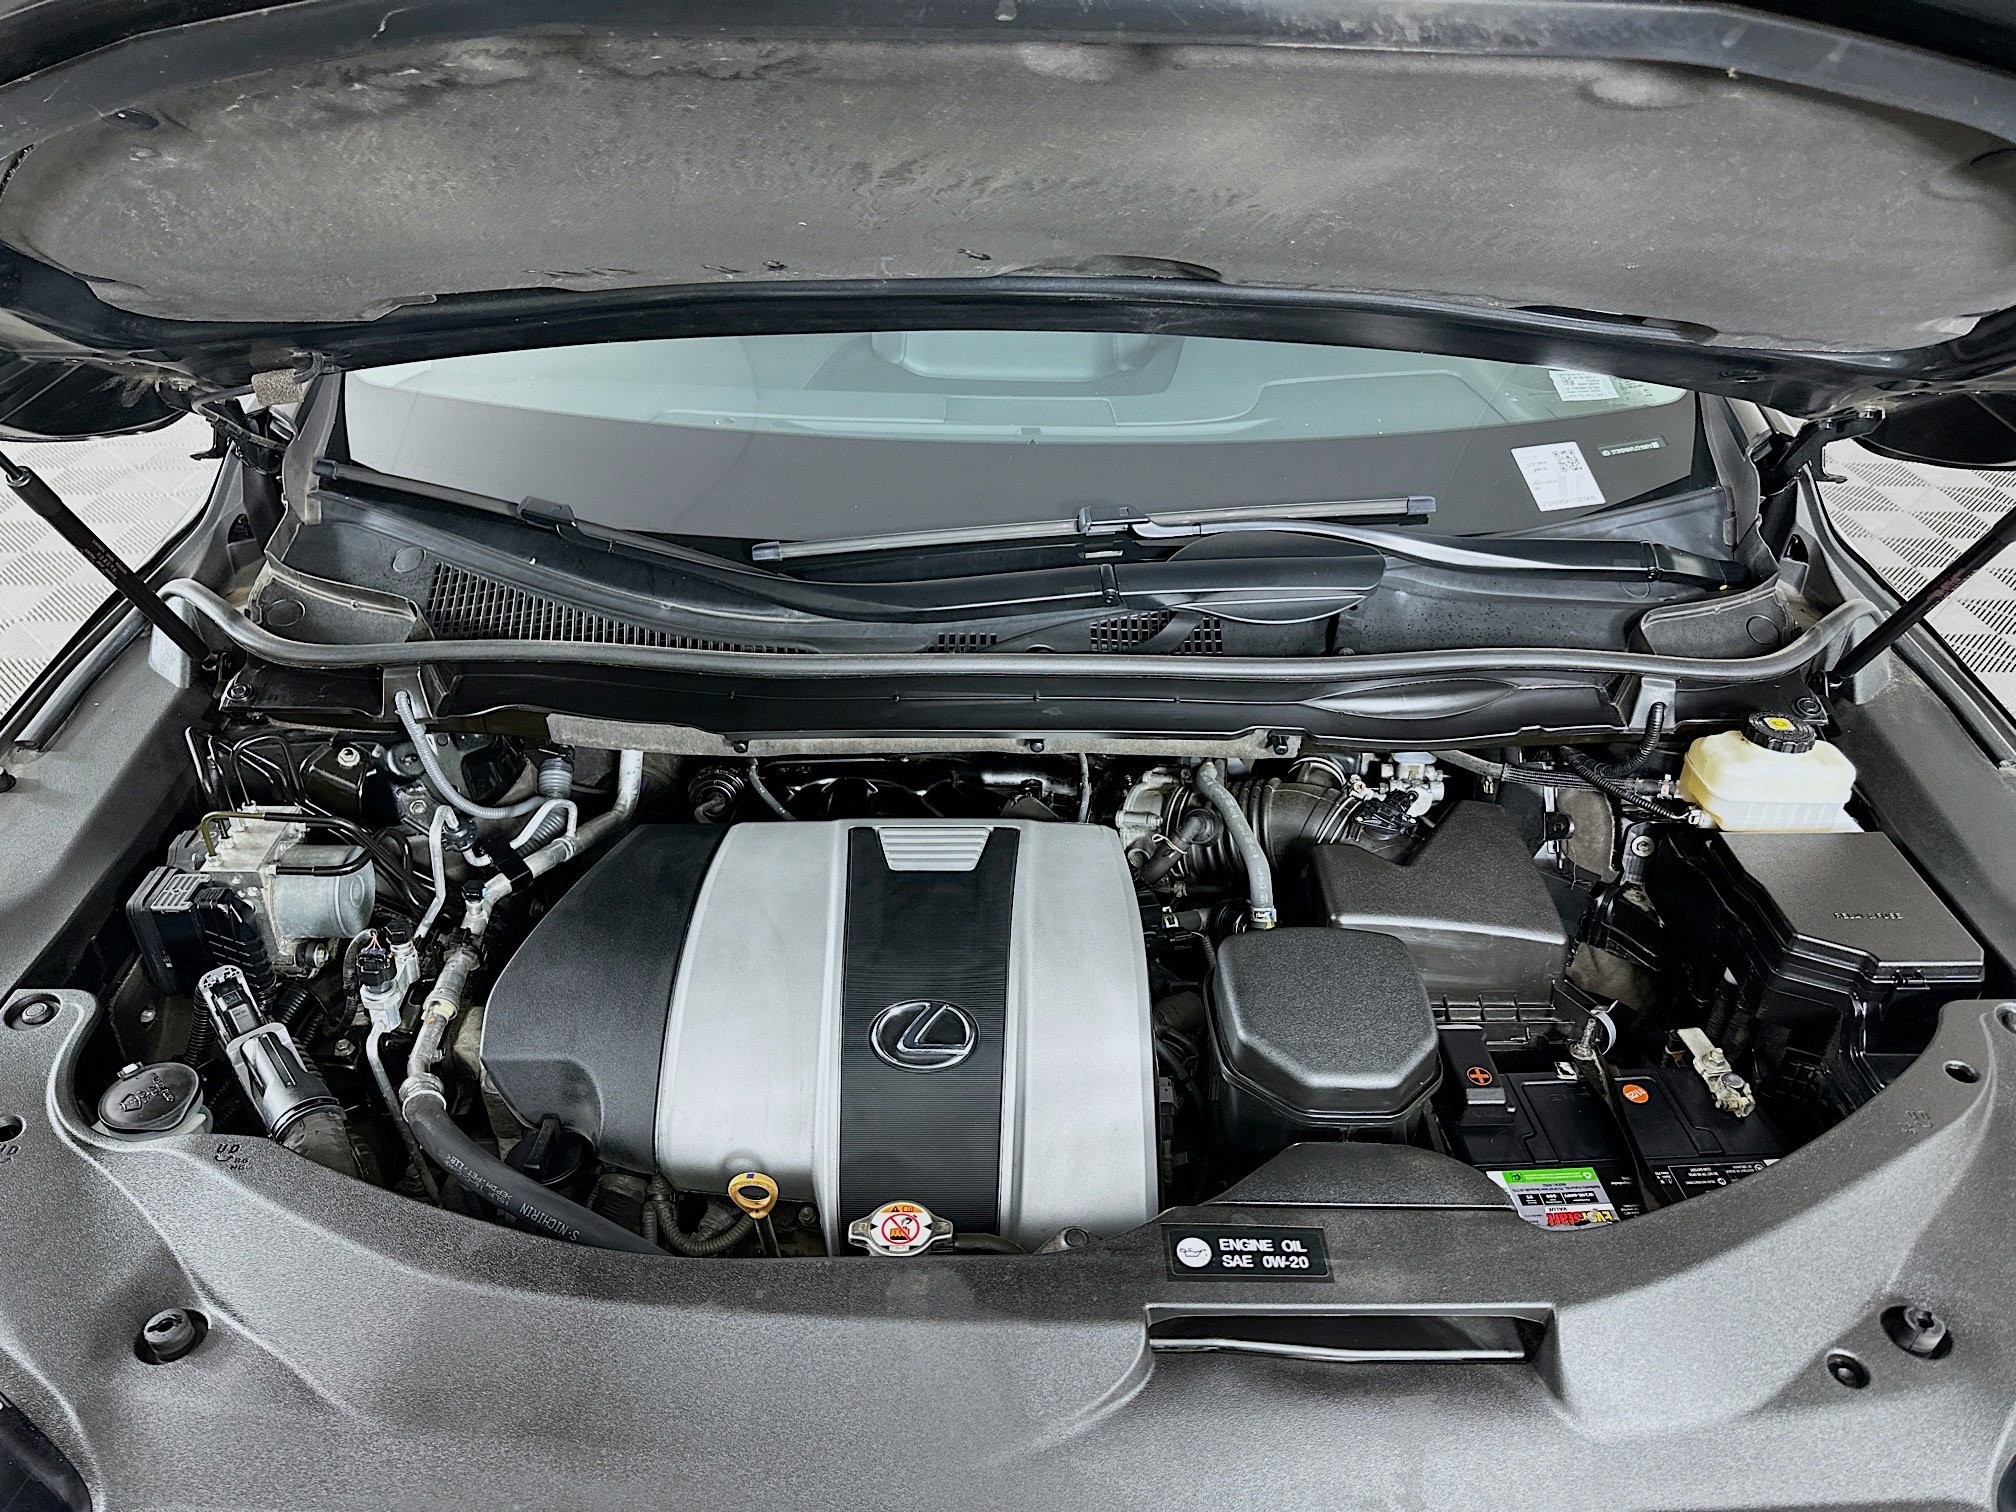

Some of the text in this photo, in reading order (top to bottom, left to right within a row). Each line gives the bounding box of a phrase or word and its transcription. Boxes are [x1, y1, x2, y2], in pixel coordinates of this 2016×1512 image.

[1218, 1238, 1308, 1253] ENGINE OIL
[1221, 1254, 1310, 1269] SAE 0W-20
